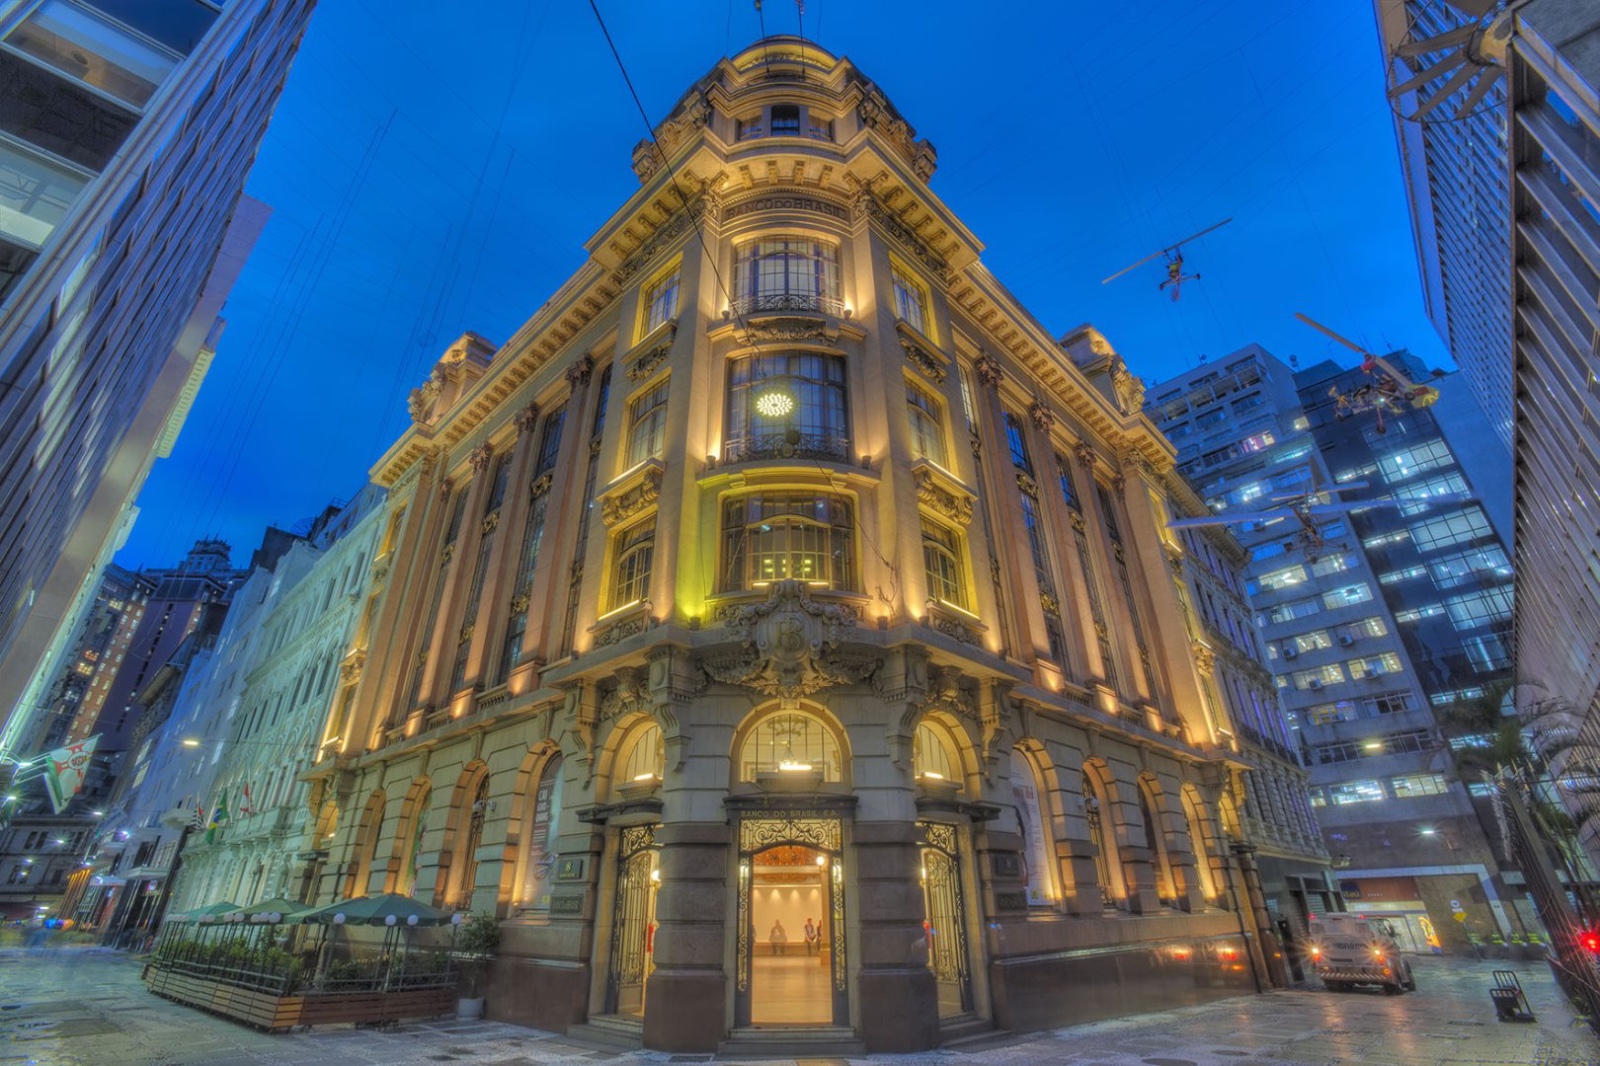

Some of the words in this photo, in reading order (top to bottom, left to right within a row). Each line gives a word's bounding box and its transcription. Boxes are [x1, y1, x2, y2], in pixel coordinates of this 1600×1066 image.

[727, 199, 774, 217] BANCO
[795, 199, 846, 218] BRASIL
[740, 810, 769, 818] BANCO
[774, 810, 786, 818] DO
[790, 810, 818, 818] BRASIL
